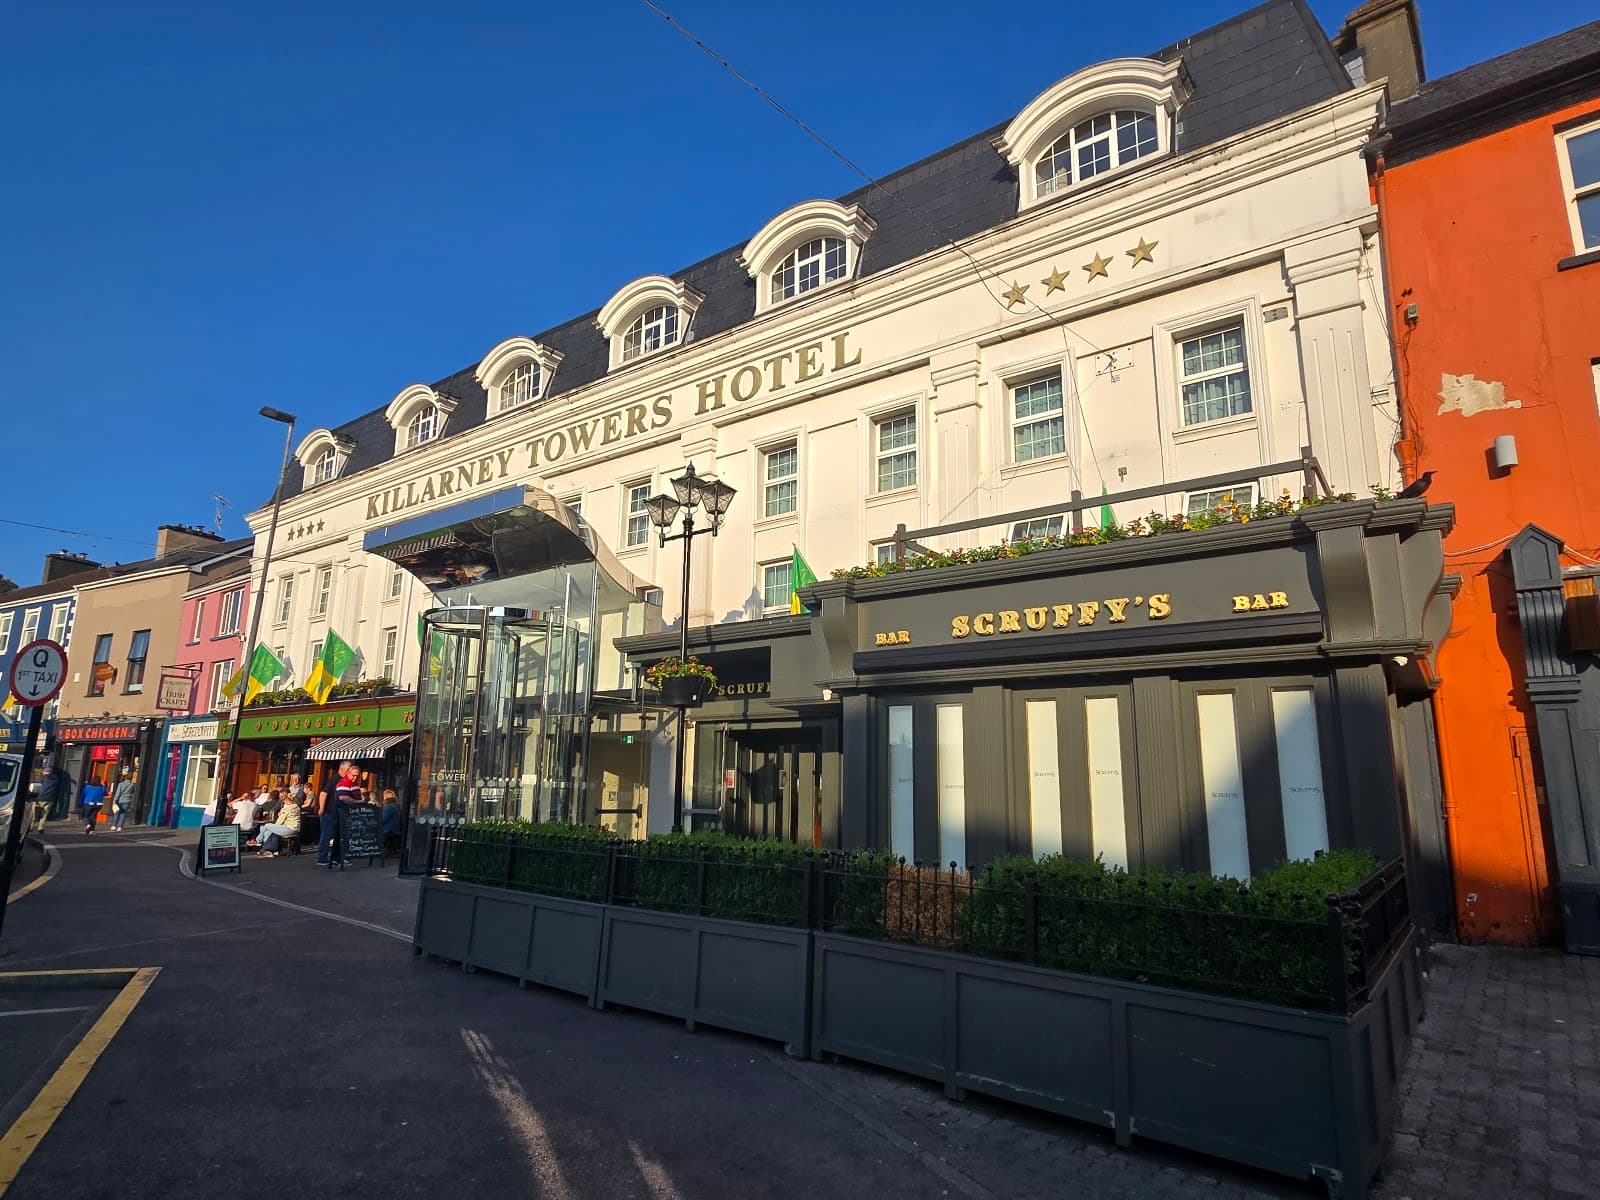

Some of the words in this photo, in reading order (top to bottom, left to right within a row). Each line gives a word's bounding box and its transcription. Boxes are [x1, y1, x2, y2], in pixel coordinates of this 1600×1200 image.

[366, 448, 514, 520] KILLARNEY
[527, 395, 672, 468] TOWERS
[695, 331, 863, 416] HOTEL
[1233, 591, 1289, 612] BAR
[951, 592, 1172, 639] SCRUFFY'S
[875, 630, 911, 646] BAR
[33, 649, 49, 668] Q
[33, 671, 58, 683] TAXI
[64, 728, 84, 739] BOX
[85, 726, 129, 739] CHICKEN
